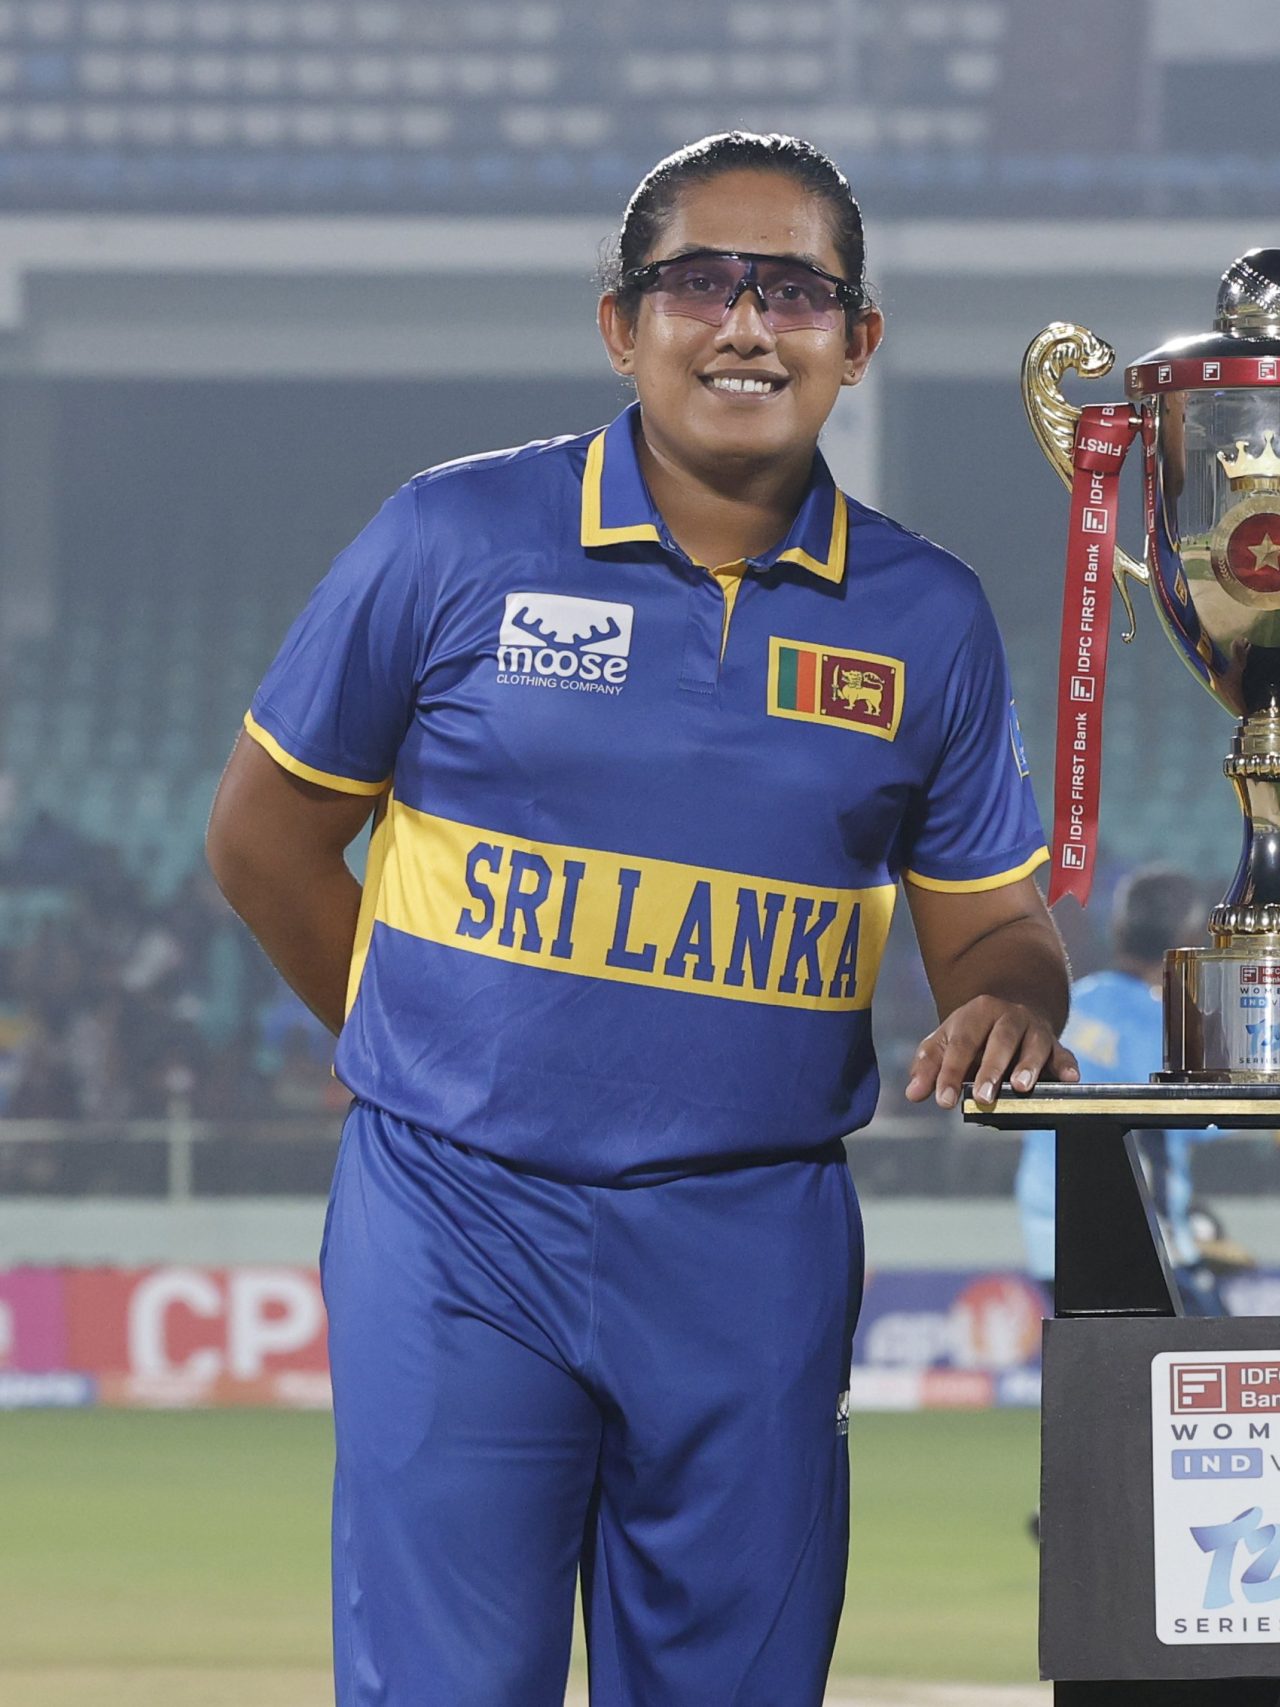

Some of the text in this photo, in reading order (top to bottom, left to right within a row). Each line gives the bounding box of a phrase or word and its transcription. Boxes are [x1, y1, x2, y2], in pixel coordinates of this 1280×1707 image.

[1077, 437, 1122, 457] FIRST
[1089, 470, 1105, 505] IDFC
[1077, 543, 1101, 672] IDFC FIRST Bank
[496, 645, 629, 684] moose
[496, 673, 624, 696] CLOTHING COMPANY
[1070, 712, 1088, 840] IDFC FIRST Bank
[456, 841, 862, 999] SRI LANKA
[1184, 1454, 1251, 1473] IND
